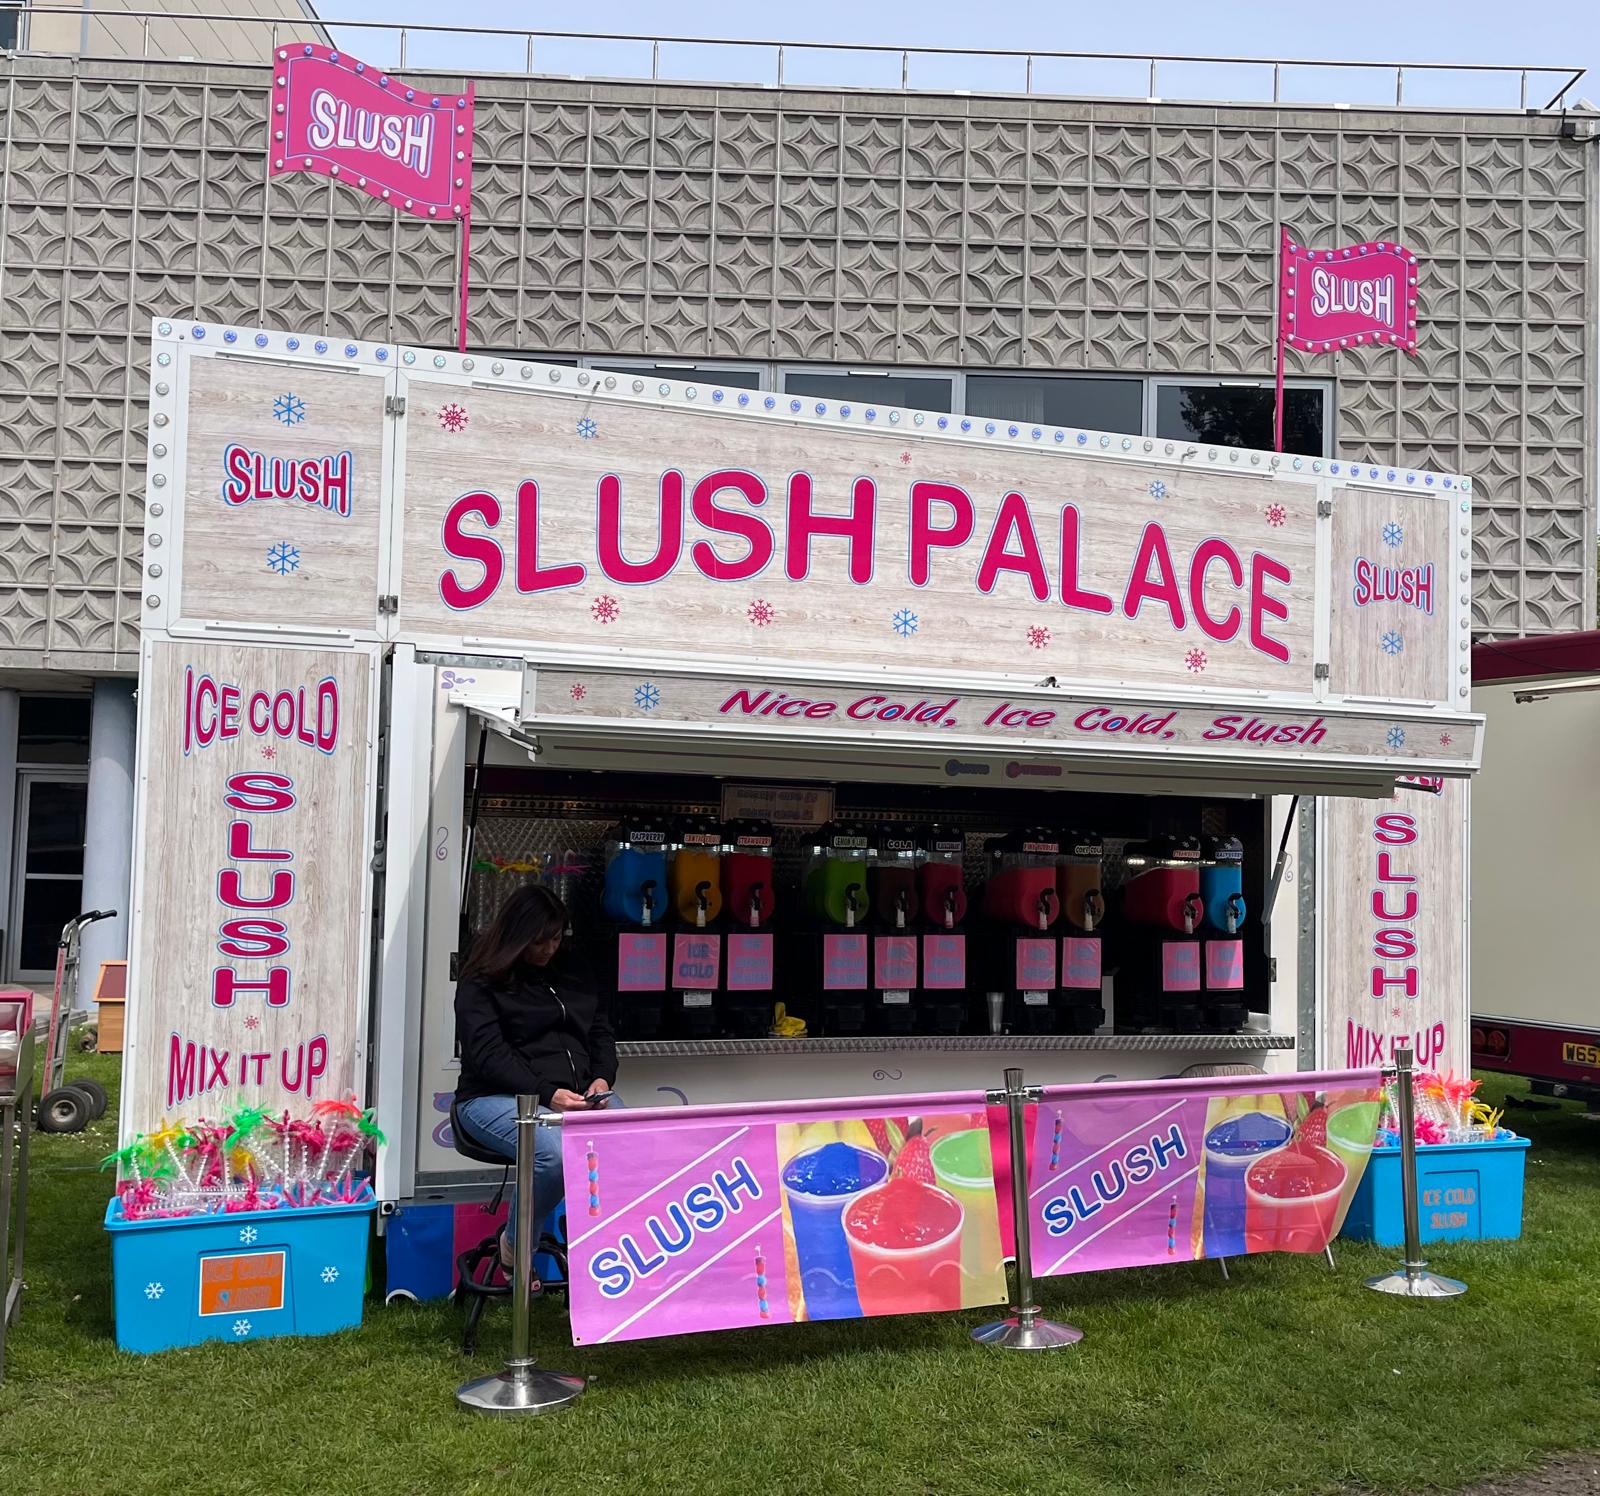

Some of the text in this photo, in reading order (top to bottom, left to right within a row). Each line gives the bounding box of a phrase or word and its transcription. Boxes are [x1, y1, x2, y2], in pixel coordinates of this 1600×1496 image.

[308, 88, 435, 178] SLUSH
[1311, 267, 1394, 328] SLUSH
[223, 443, 352, 517] SLUSH
[438, 468, 1292, 665] SLUSH PALACE
[1353, 557, 1434, 615] SLUSH
[184, 664, 339, 757] ICE COLD
[719, 689, 1328, 746] Nice Cold, Ice Cold, Slush
[887, 839, 913, 850] COLA
[212, 772, 297, 1008] SLUSH
[1371, 812, 1420, 1000] SLUSH
[166, 1031, 328, 1111] MIX IT UP
[1346, 1017, 1384, 1070] MIX
[1415, 1020, 1446, 1072] UP
[1566, 1044, 1600, 1064] W65
[1042, 1122, 1189, 1238] SLUSH
[1424, 1188, 1476, 1206] ICE COLD
[588, 1155, 762, 1298] SLUSH
